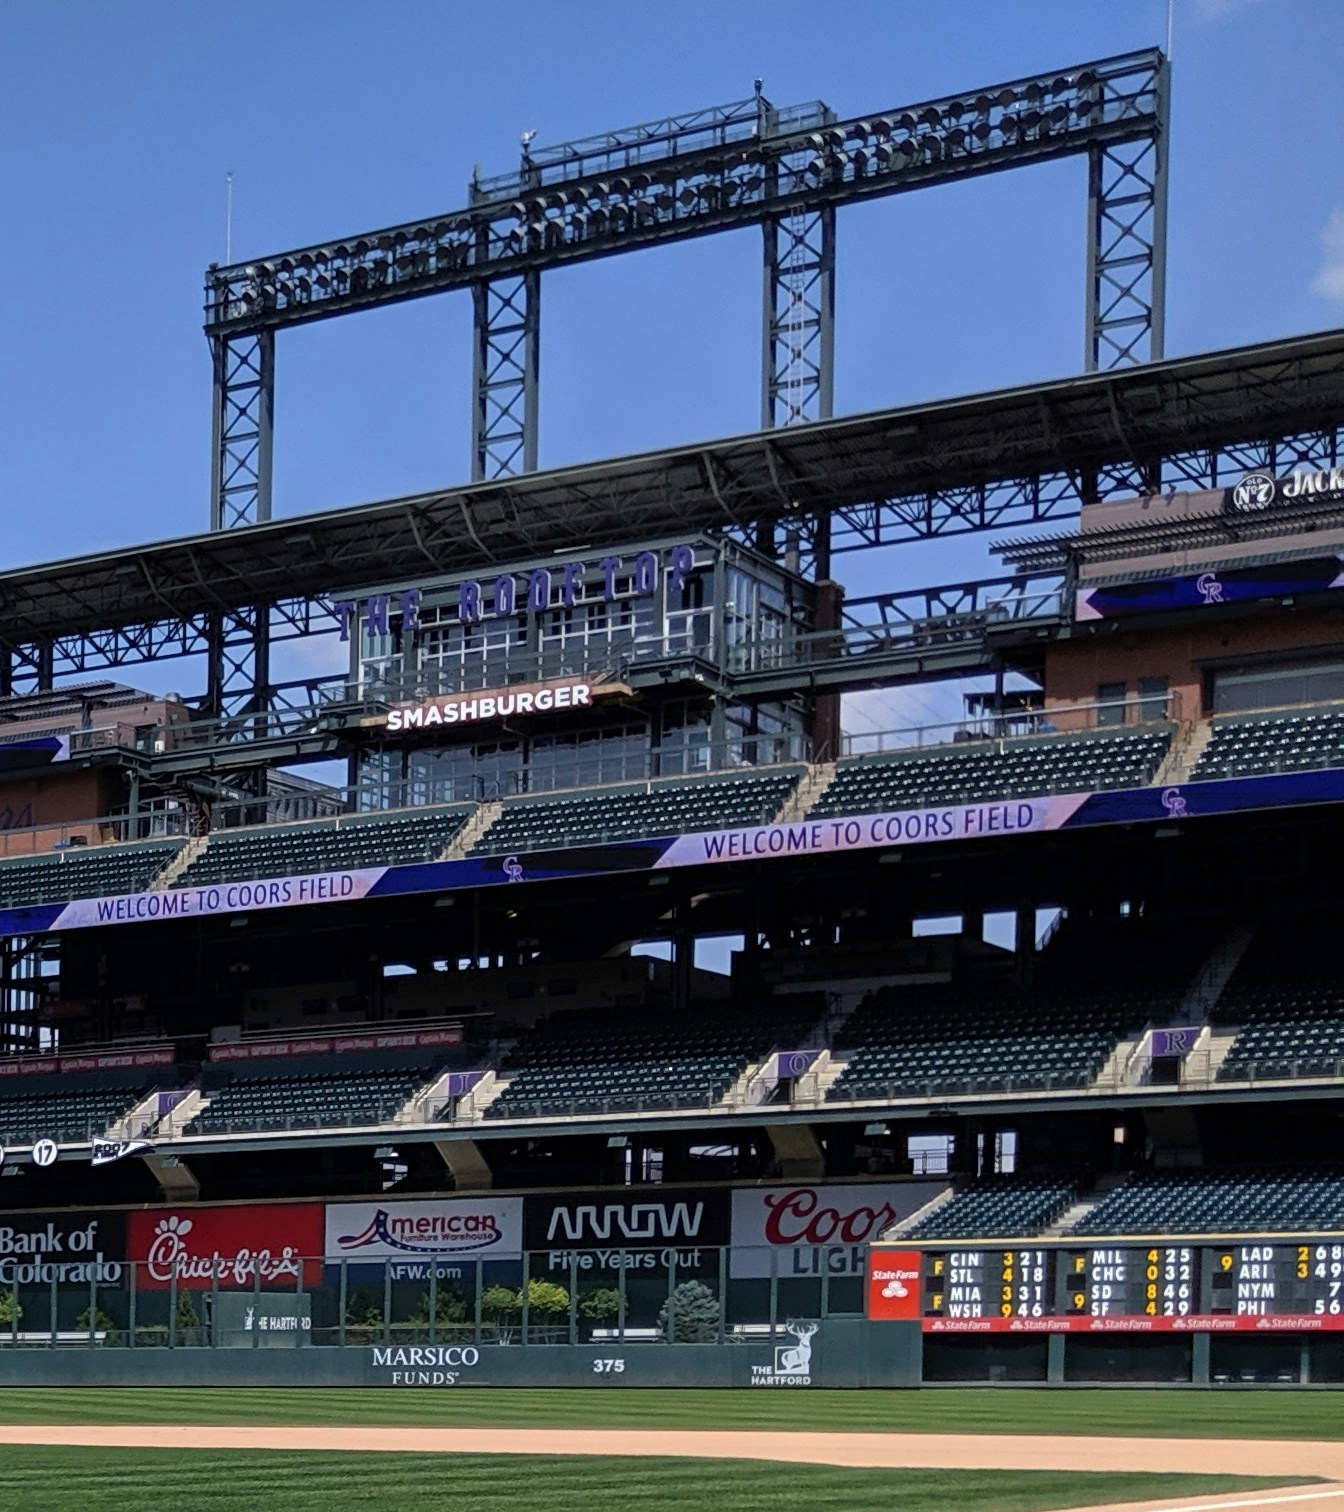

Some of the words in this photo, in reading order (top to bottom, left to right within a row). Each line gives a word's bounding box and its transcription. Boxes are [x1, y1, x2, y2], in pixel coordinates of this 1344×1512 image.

[334, 588, 422, 642] THE
[459, 545, 696, 623] ROOFTOP
[386, 684, 591, 730] SMASHBURGER
[703, 829, 823, 860] WELCOME
[833, 822, 862, 846] TO
[868, 813, 954, 842] COORS
[963, 803, 1034, 834] FIELD
[96, 886, 191, 923] WELCOME
[196, 887, 220, 912] TO
[227, 879, 292, 909] COORS
[299, 874, 354, 900] FIELD
[38, 1145, 52, 1163] 17
[338, 1208, 496, 1236] American
[546, 1202, 704, 1241] ARROW
[68, 1221, 97, 1252] of
[400, 1232, 439, 1242] Furniture
[441, 1232, 493, 1241] Warehouse
[148, 1230, 299, 1284] Chick-fil-A
[548, 1251, 594, 1270] Five
[595, 1250, 656, 1269] Years
[661, 1249, 701, 1268] Out
[950, 1253, 979, 1266] CIN
[1003, 1252, 1013, 1265] 3
[1092, 1250, 1123, 1264] MIL
[1147, 1249, 1158, 1263] 4
[1241, 1247, 1273, 1261] LAD
[1298, 1247, 1309, 1260] 2
[934, 1260, 944, 1275] F
[1075, 1258, 1086, 1273] F
[1221, 1255, 1232, 1271] 9
[950, 1269, 974, 1283] STL
[1002, 1268, 1012, 1282] 4
[1092, 1267, 1126, 1281] CHC
[1147, 1265, 1158, 1280] 0
[1239, 1264, 1268, 1279] ARI
[1297, 1263, 1308, 1278] 3
[950, 1287, 981, 1301] MIA
[1002, 1286, 1012, 1300] 3
[1091, 1285, 1112, 1299] SD
[1147, 1284, 1157, 1299] 8
[1238, 1282, 1274, 1298] NYM
[1329, 1282, 1341, 1297] 7
[933, 1295, 943, 1310] F
[1074, 1294, 1084, 1308] 9
[1091, 1302, 1110, 1316] SF
[1145, 1301, 1156, 1316] 4
[1237, 1301, 1265, 1316] PHI
[949, 1303, 982, 1318] WSH
[1001, 1304, 1011, 1318] 9
[372, 1347, 479, 1366] MARSICO
[593, 1359, 625, 1373] 375
[751, 1366, 772, 1375] THE
[392, 1371, 455, 1385] FUNDS
[751, 1376, 811, 1385] HARTFORD
